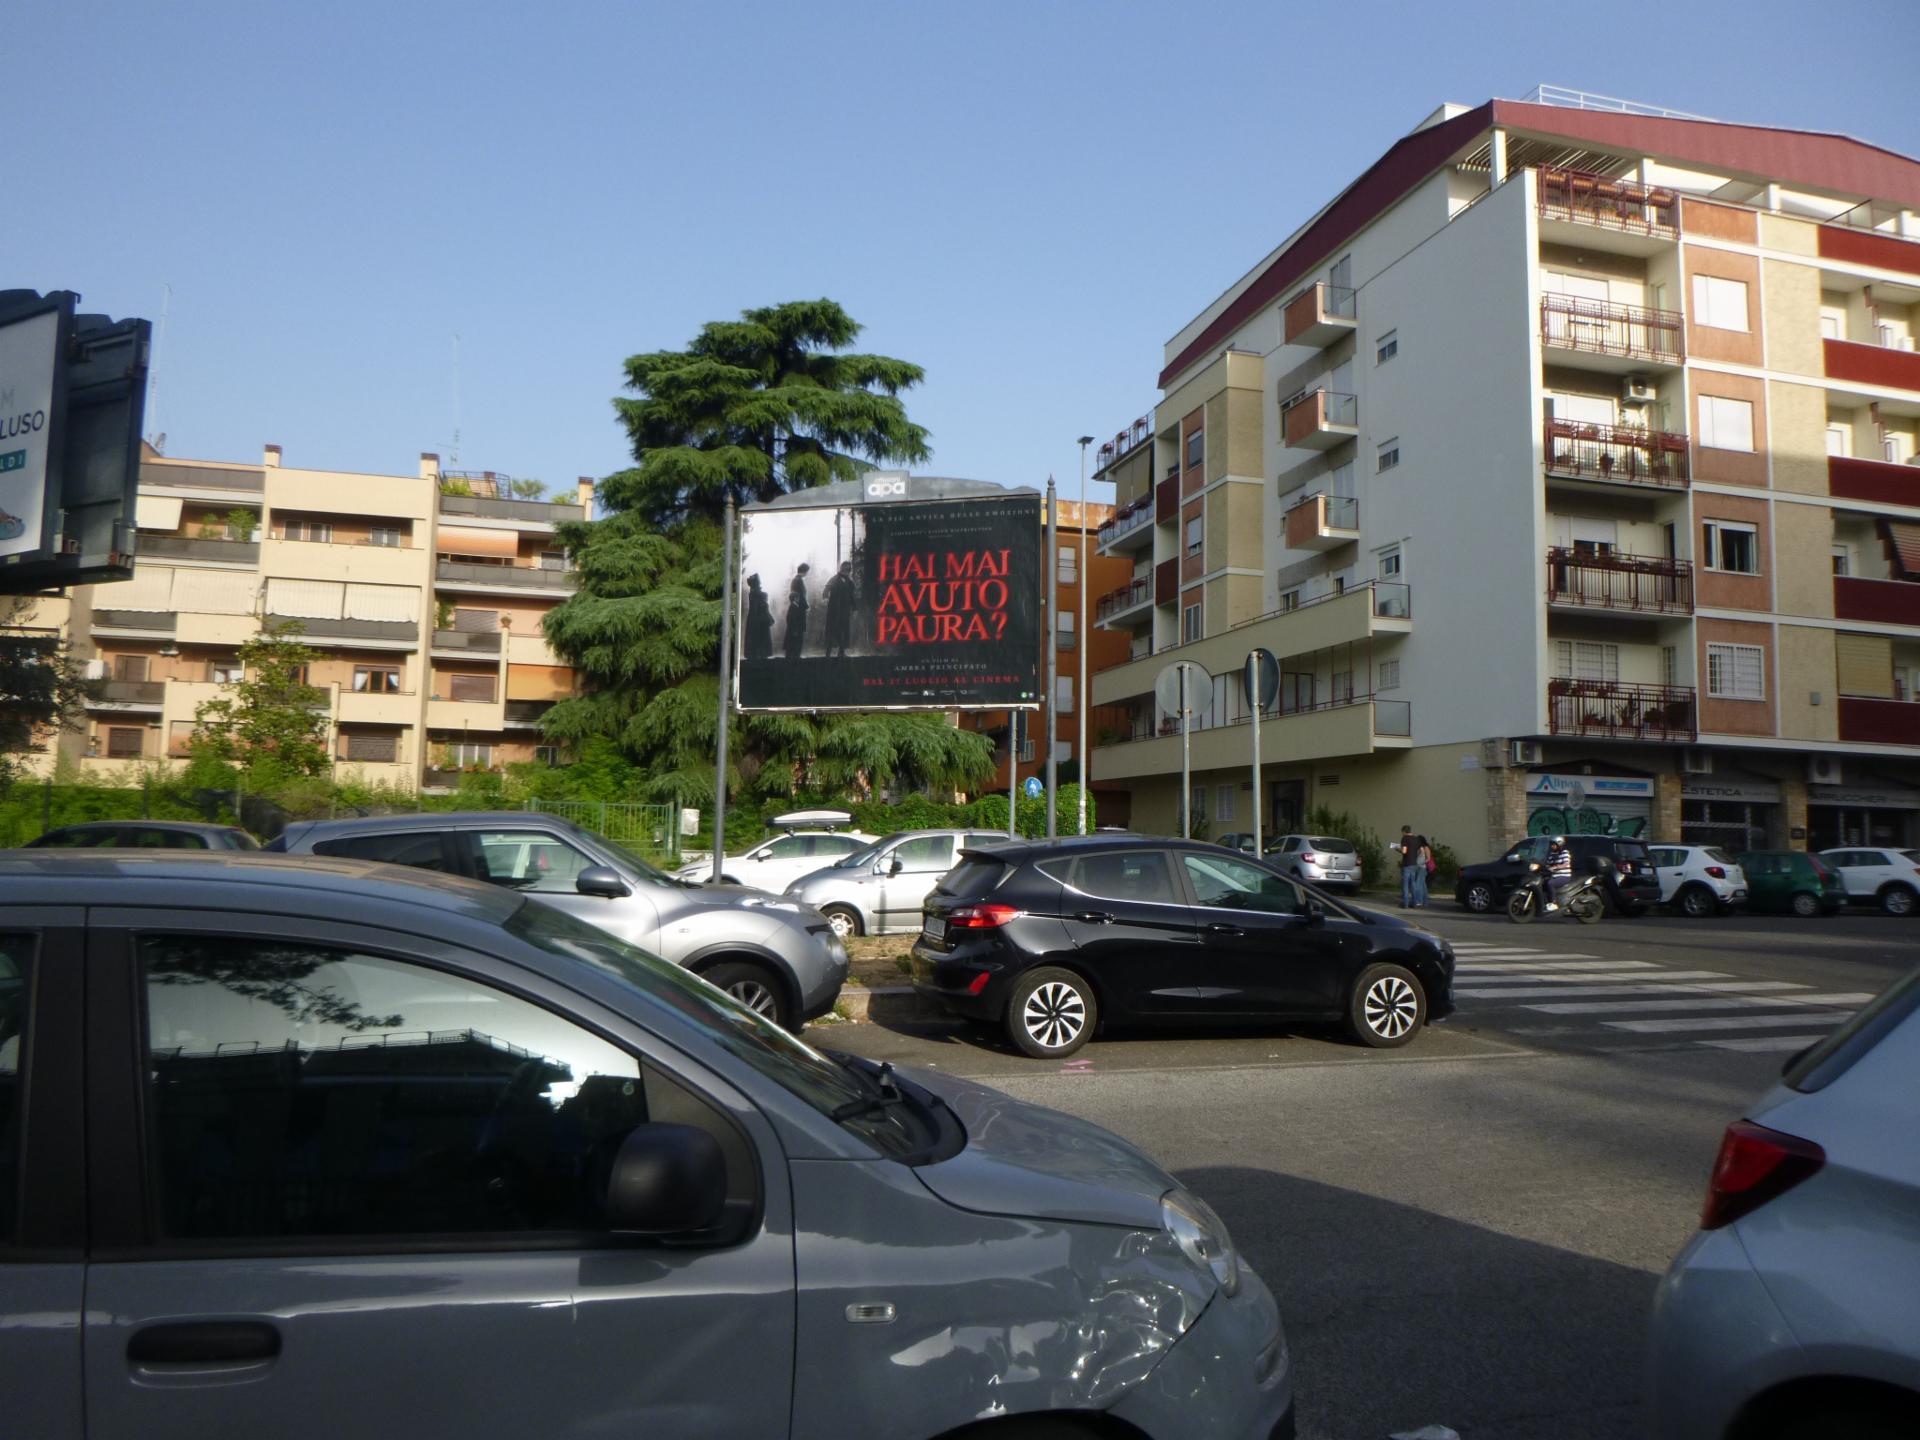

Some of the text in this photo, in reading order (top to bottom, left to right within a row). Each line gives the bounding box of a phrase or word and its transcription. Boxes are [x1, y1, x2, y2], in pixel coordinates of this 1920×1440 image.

[868, 481, 906, 498] apa
[878, 548, 1011, 582] HAI MAI
[878, 578, 1009, 614] AVUTO
[877, 610, 1009, 645] PAURA?
[972, 673, 1021, 685] CINEMA
[1681, 786, 1742, 797] ESTETICA
